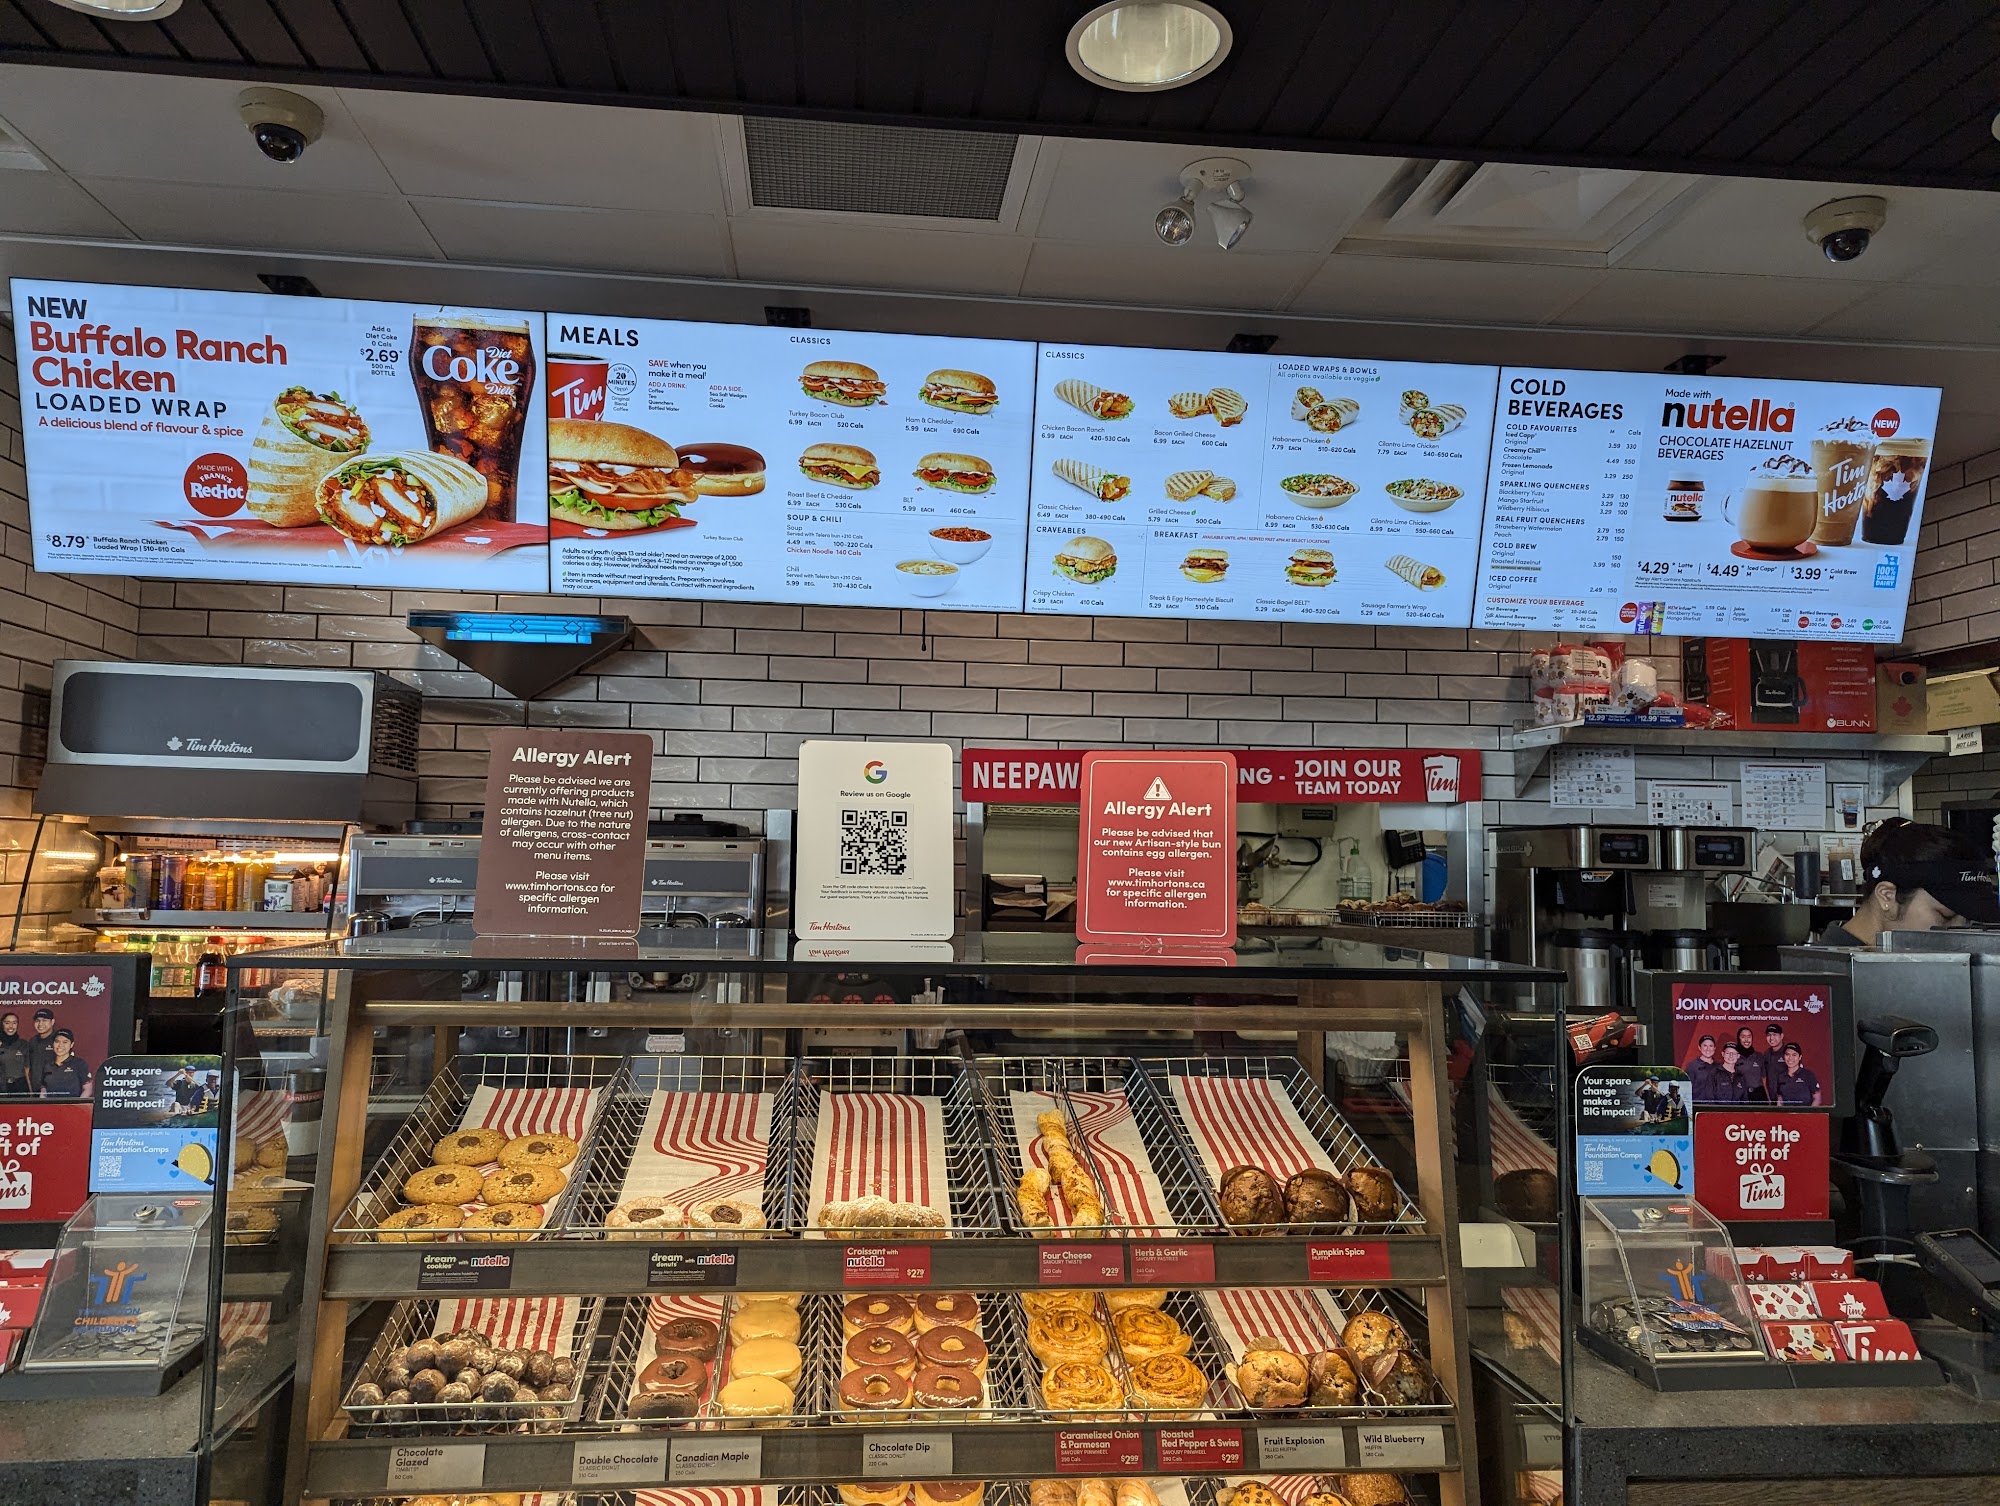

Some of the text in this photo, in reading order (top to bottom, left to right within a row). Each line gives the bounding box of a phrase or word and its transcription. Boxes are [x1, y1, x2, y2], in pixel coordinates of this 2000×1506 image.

[28, 296, 87, 319] NEW
[561, 326, 638, 346] MEALS
[31, 321, 287, 365] Buffalo Ranch
[485, 345, 513, 362] Diet
[422, 344, 520, 386] Coke
[1279, 364, 1309, 372] LOADED
[33, 356, 175, 392] Chicken
[1511, 379, 1565, 395] COLD
[1666, 389, 1711, 398] Made with
[36, 393, 226, 418] LOADED WRAP
[1509, 400, 1623, 419] BEVERAGES
[789, 410, 808, 418] Turkey
[1662, 397, 1795, 432] nutella
[39, 416, 243, 438] A delicious blend of flavour & spice
[1873, 419, 1898, 429] NEW!
[1659, 436, 1793, 450] CHOCOLATE HAZELNUT
[1658, 449, 1723, 460] BEVERAGES
[198, 471, 233, 485] FRANK'S
[189, 482, 245, 501] RedHot
[187, 739, 253, 753] Tim Hortons
[512, 748, 631, 767] Allergy Alert
[973, 761, 1082, 789] NEEPAW
[1294, 760, 1401, 779] JOIN OUR
[510, 774, 541, 783] Please
[543, 776, 556, 784] be
[558, 776, 596, 785] advised
[1294, 781, 1401, 795] TEAM TODAY
[501, 807, 586, 816] contains hazelnut
[1104, 801, 1212, 819] Allergy Alert
[1112, 839, 1133, 847] new
[1135, 839, 1199, 850] Artisan-style
[1202, 840, 1221, 848] bun
[1103, 848, 1166, 860] contains egg
[810, 922, 850, 930] Tim Hortons
[23, 982, 78, 994] LOCAL
[1675, 997, 1801, 1012] JOIN YOUR LOCAL
[1583, 1076, 1631, 1087] Your spare
[1583, 1086, 1616, 1097] change
[1583, 1096, 1612, 1105] makes
[1583, 1106, 1636, 1119] BIG impact!
[17, 1117, 55, 1136] the
[1725, 1124, 1800, 1142] Give the
[16, 1137, 41, 1155] of
[1735, 1143, 1790, 1166] gift of
[1743, 1179, 1780, 1203] Tims
[847, 1247, 886, 1255] Croissant
[1043, 1251, 1092, 1260] Four Cheese
[1135, 1248, 1155, 1257] Herb
[1164, 1248, 1188, 1257] Garlic
[1311, 1247, 1365, 1258] Pumpkin Spice
[423, 1255, 456, 1263] dream
[470, 1254, 510, 1268] nutella
[846, 1255, 885, 1268] nutella
[1060, 1431, 1114, 1440] Caramelized
[1160, 1429, 1195, 1439] Roasted
[1385, 1435, 1424, 1444] Blueberry
[869, 1443, 930, 1453] Chocolate Dip
[1162, 1438, 1178, 1448] Red
[1179, 1439, 1208, 1449] Pepper
[1210, 1439, 1216, 1447] &
[1264, 1437, 1324, 1447] Fruit Explosion
[397, 1448, 443, 1456] Chocolate
[676, 1452, 749, 1462] Canadian Maple
[396, 1458, 428, 1466] Glazed
[580, 1455, 658, 1464] Double Chocolate
